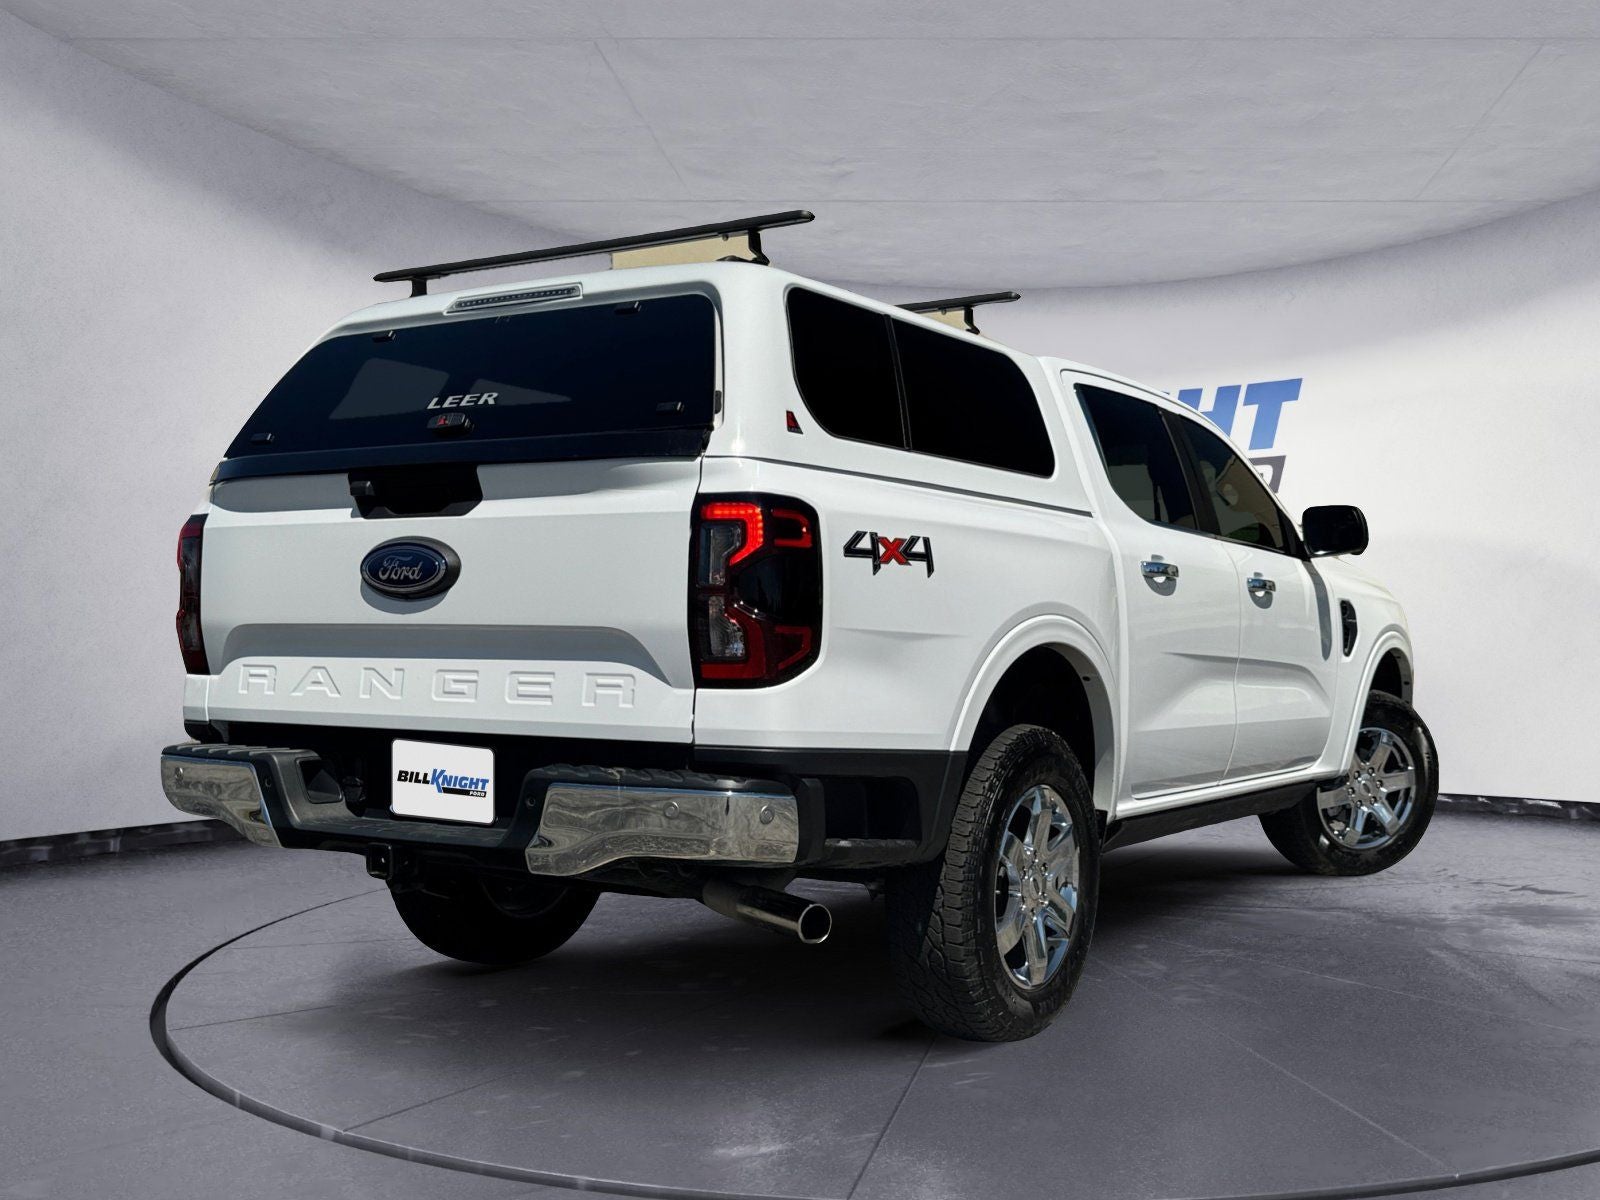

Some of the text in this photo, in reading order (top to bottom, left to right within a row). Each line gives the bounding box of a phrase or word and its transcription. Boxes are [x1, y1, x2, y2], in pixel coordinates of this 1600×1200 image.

[426, 391, 499, 410] LEER
[377, 555, 425, 581] Ford
[237, 663, 637, 708] RANGER
[396, 768, 490, 794] BILL KNIGHT
